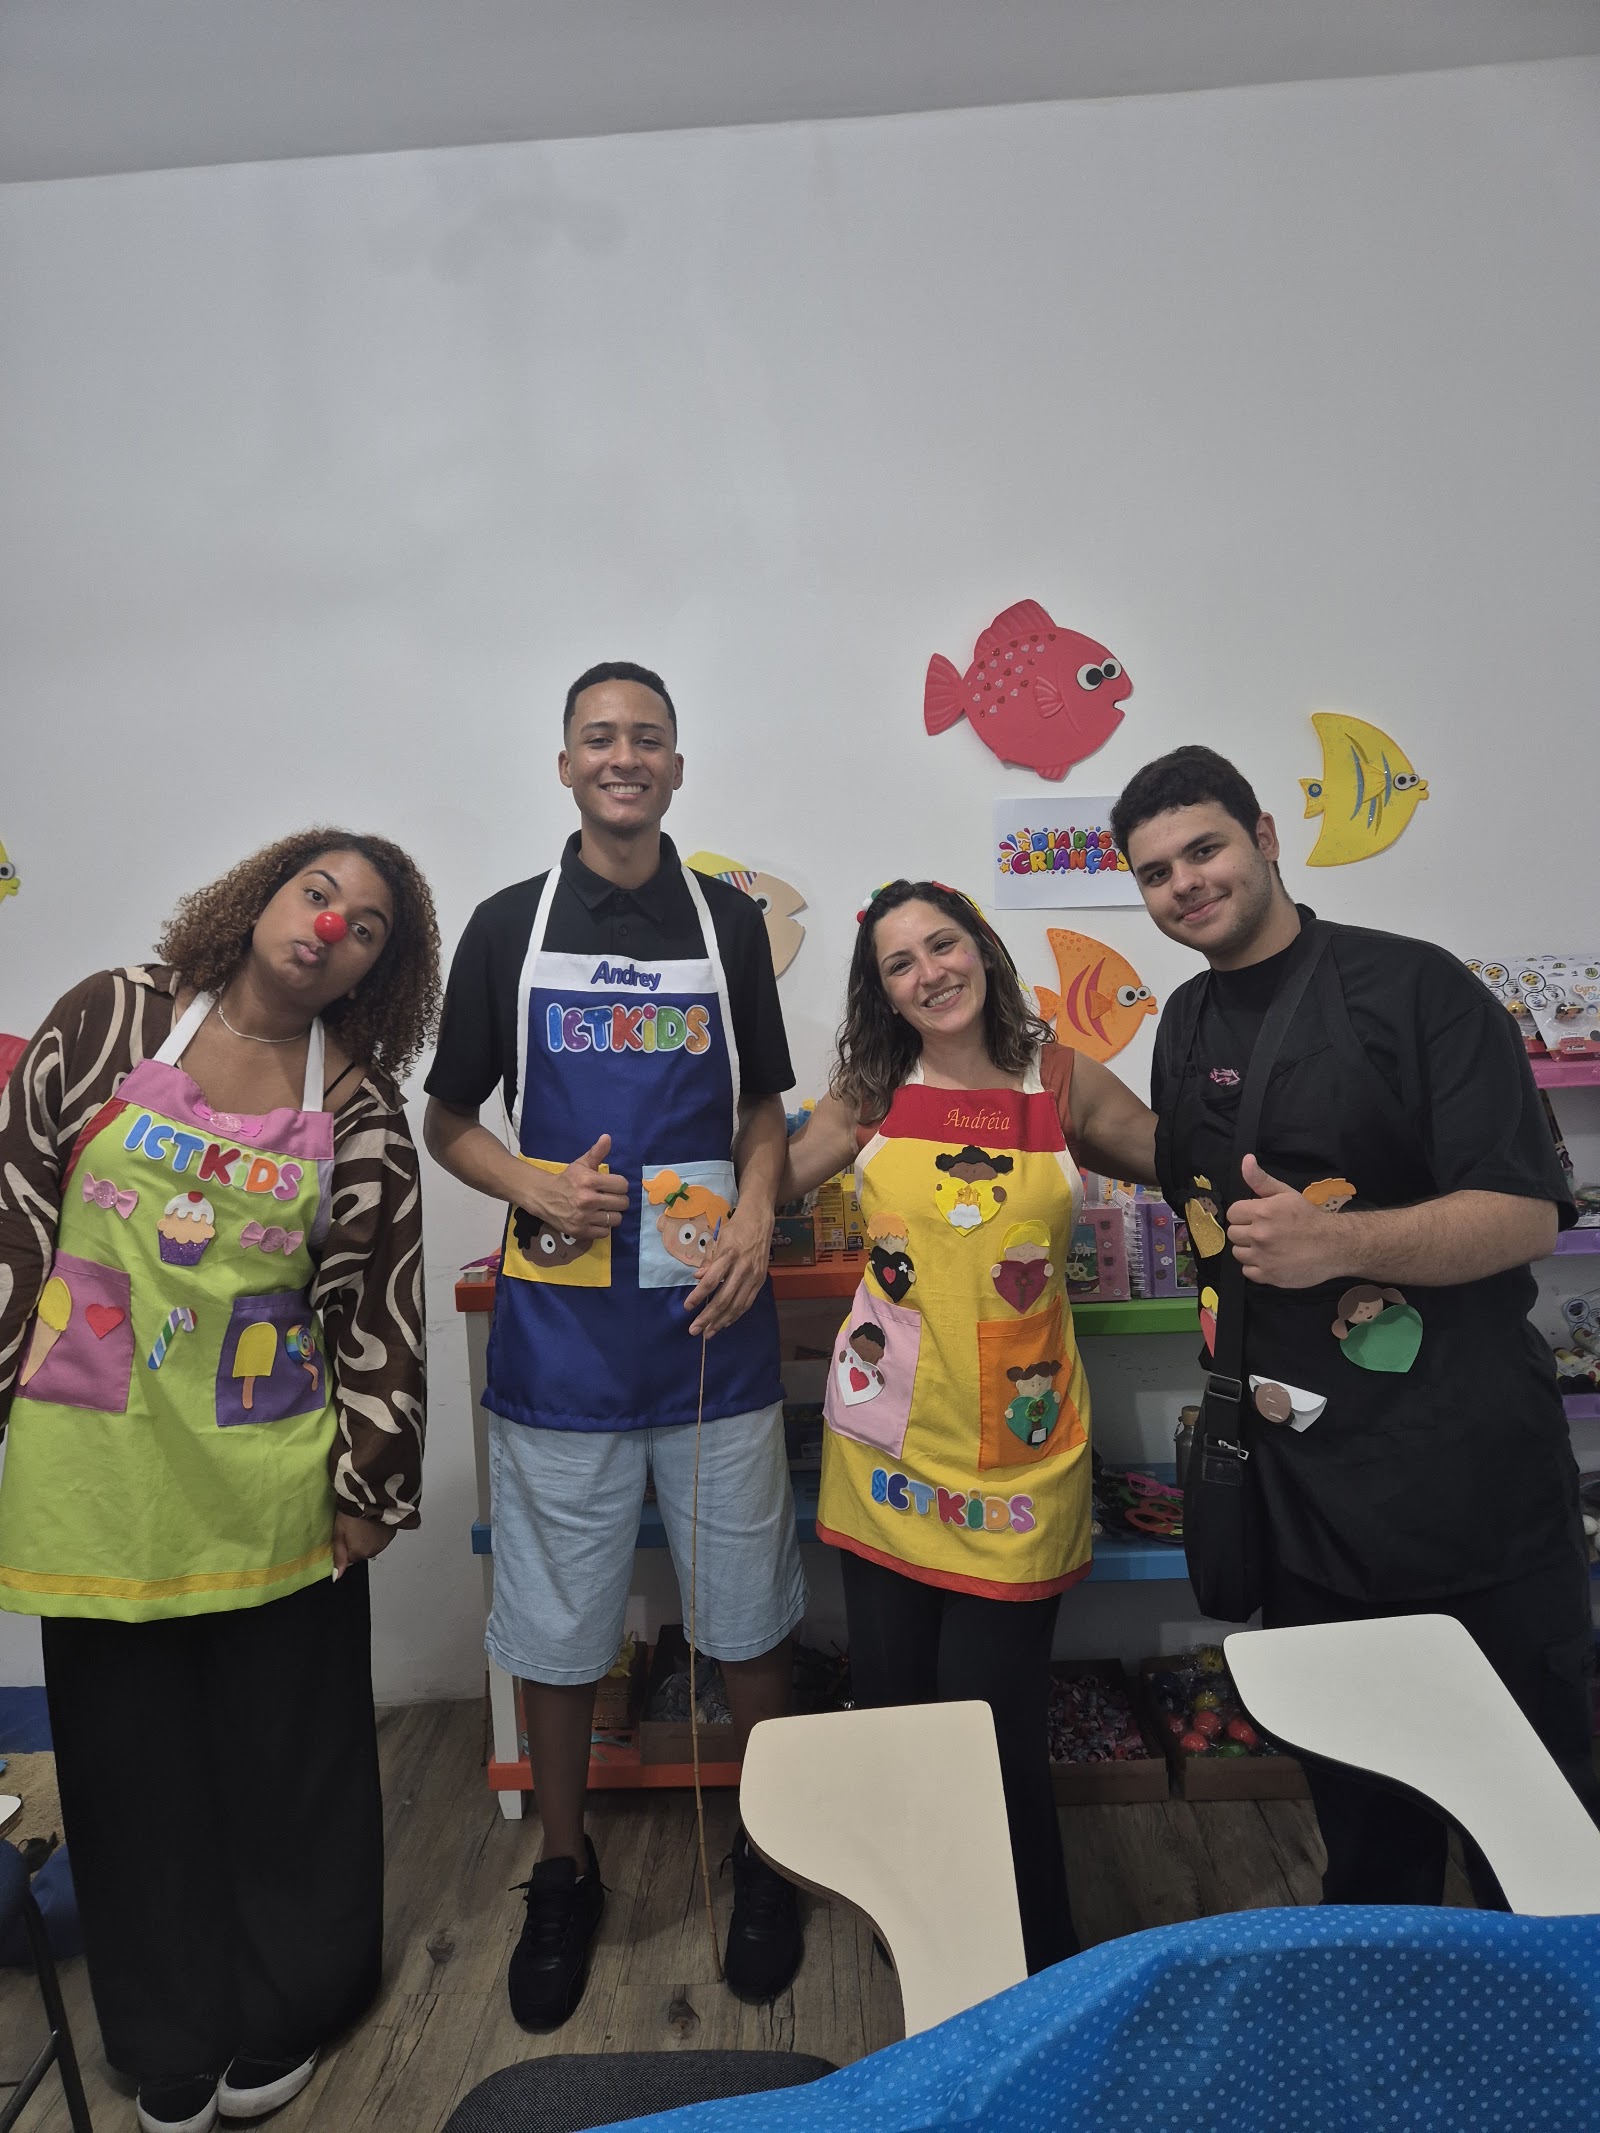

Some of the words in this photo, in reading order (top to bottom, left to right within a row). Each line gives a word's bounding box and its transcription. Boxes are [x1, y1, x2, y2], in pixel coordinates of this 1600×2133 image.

[1030, 831, 1071, 851] DIA
[1072, 831, 1113, 850] DAS
[1011, 848, 1132, 874] CRIANÇAS
[591, 960, 661, 991] Andrey
[943, 1108, 1011, 1130] Andréia
